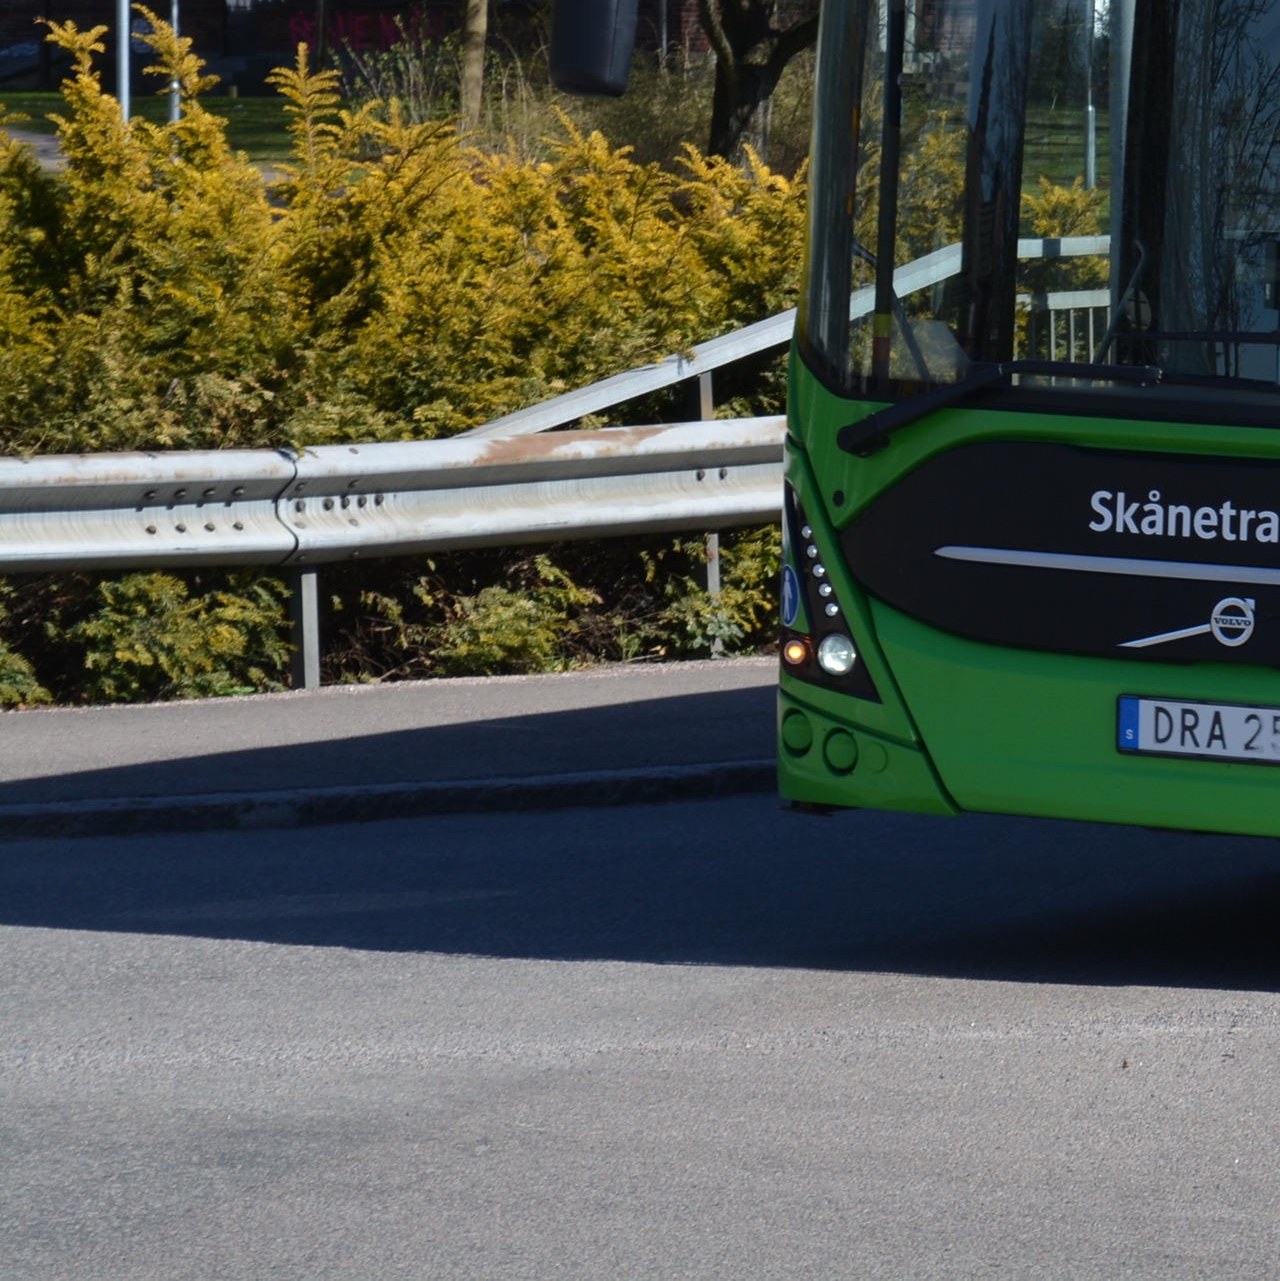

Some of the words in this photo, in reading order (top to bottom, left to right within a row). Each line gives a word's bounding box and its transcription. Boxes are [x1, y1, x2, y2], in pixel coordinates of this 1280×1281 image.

[1213, 616, 1252, 628] VOLVO
[1125, 728, 1134, 741] S
[1154, 705, 1227, 751] DRA
